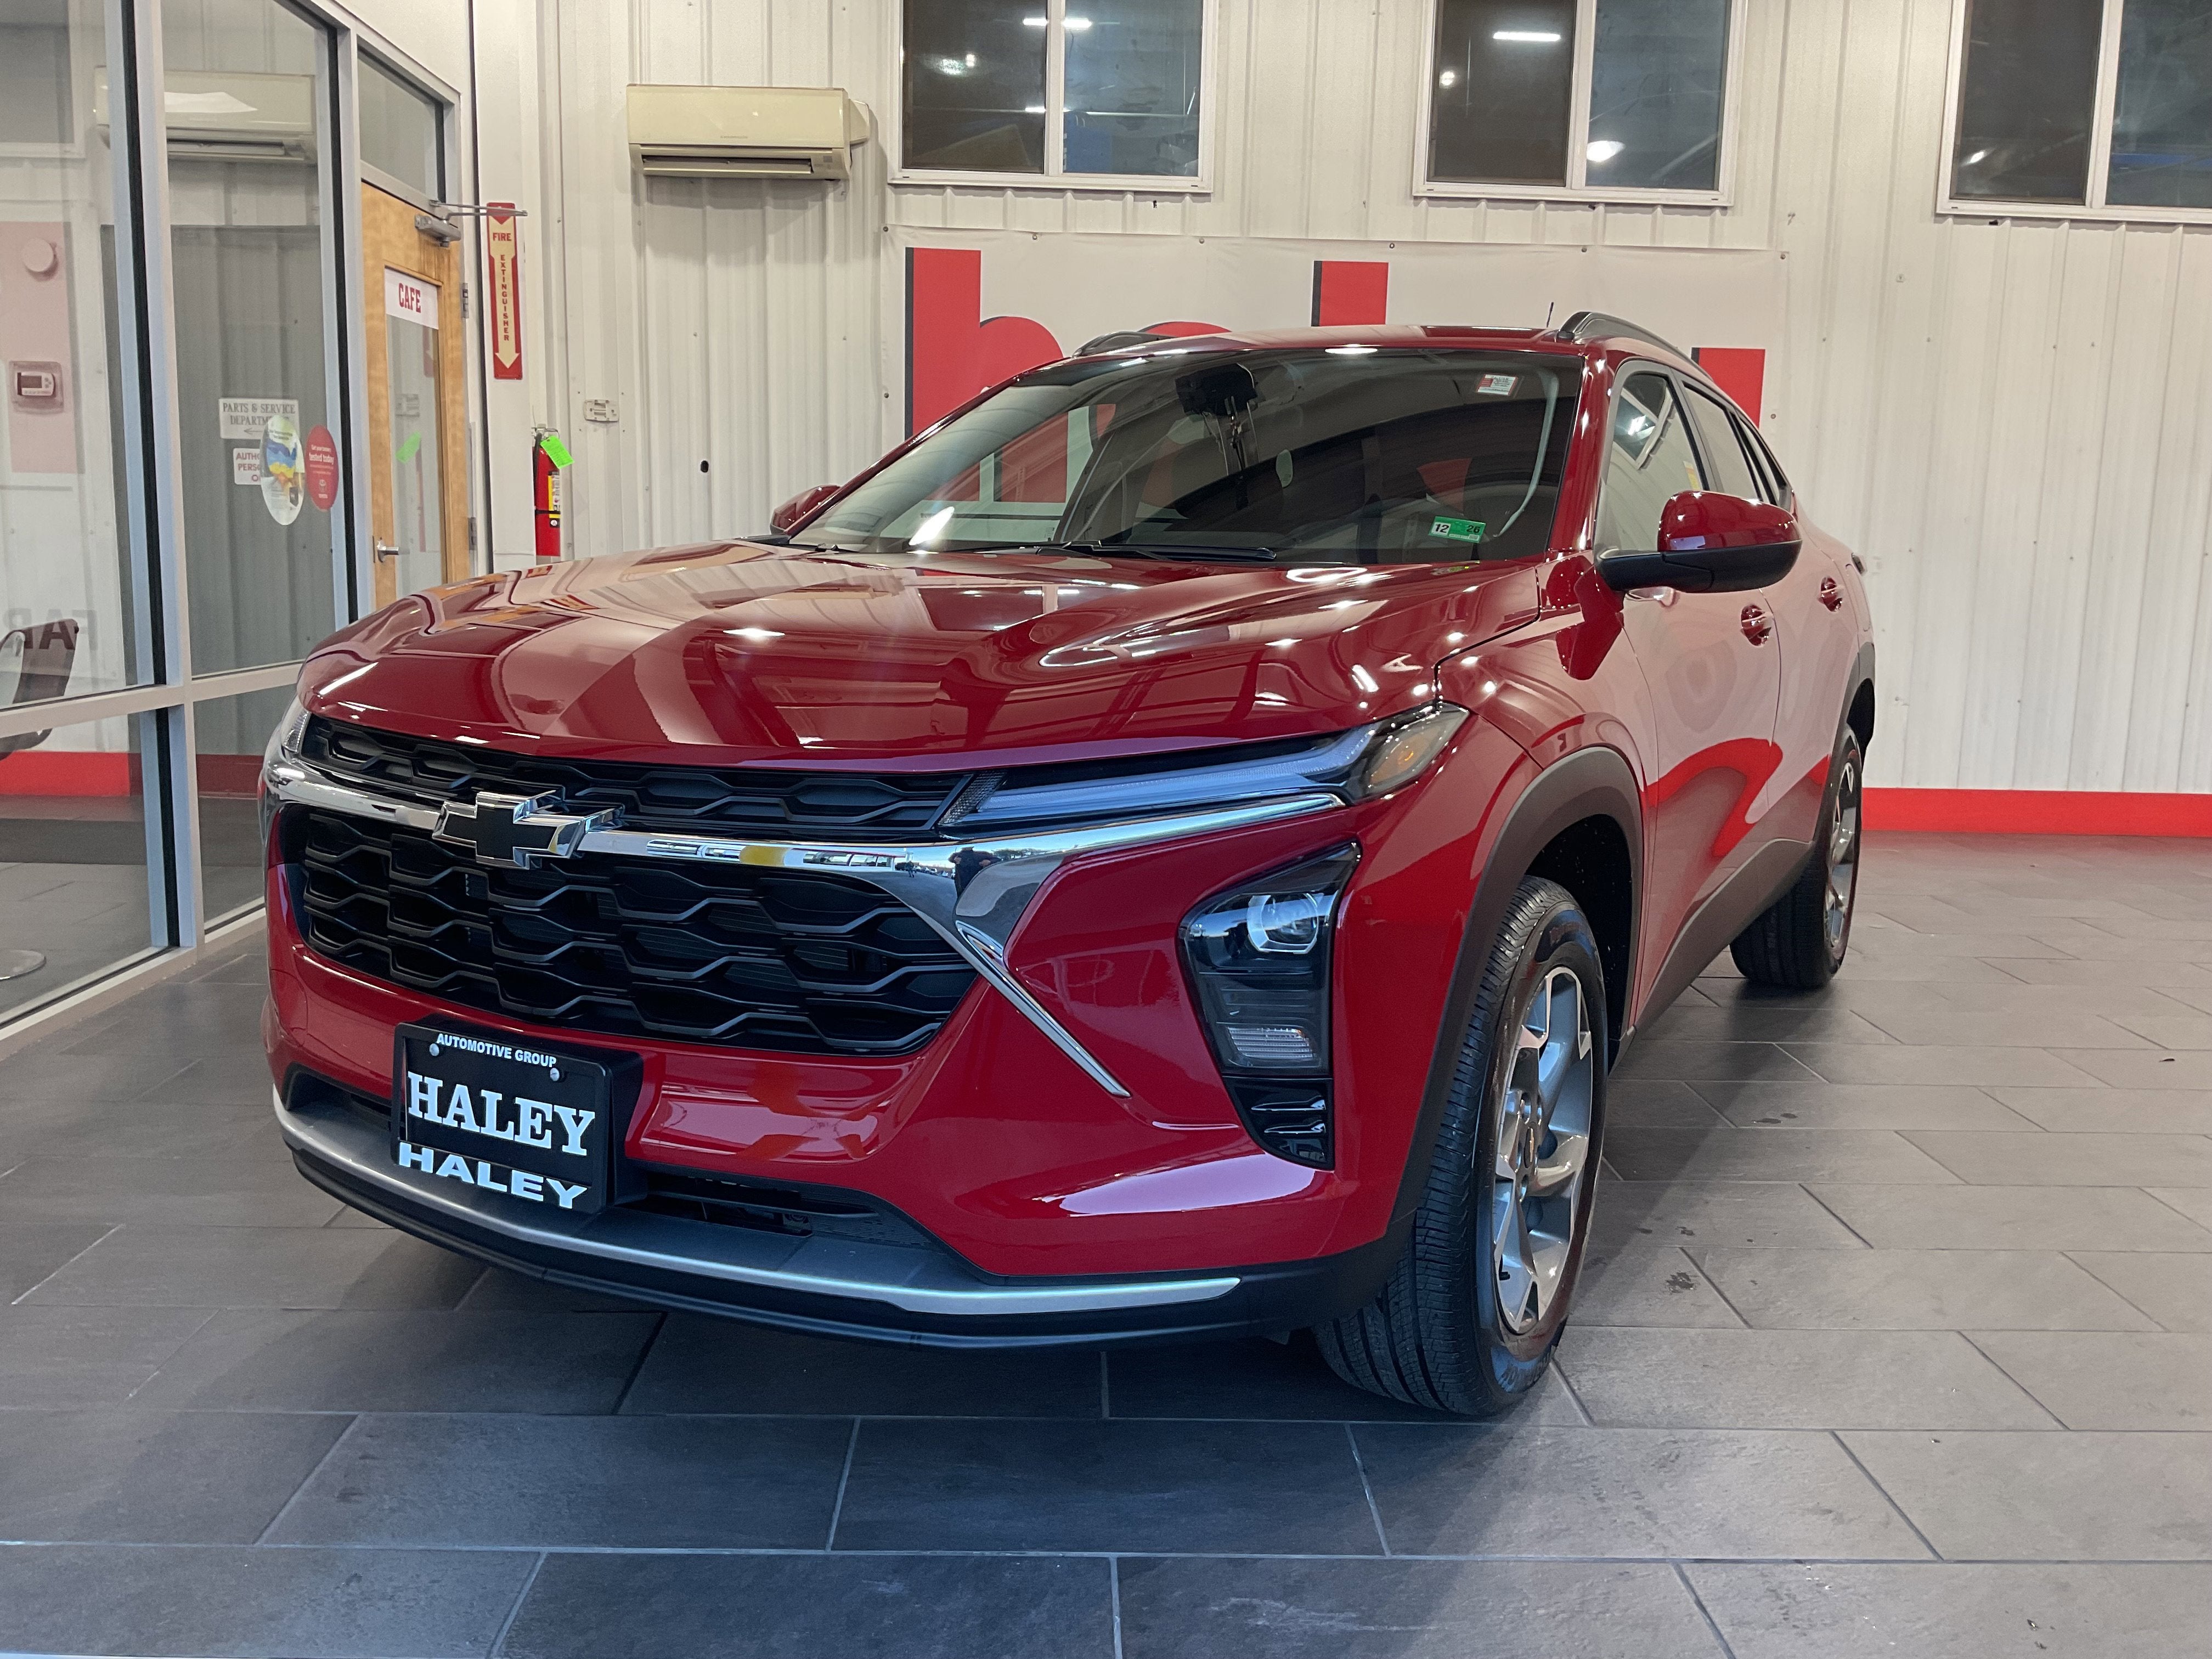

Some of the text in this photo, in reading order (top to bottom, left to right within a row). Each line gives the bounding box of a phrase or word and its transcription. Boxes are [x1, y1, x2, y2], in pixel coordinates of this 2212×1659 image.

[493, 232, 512, 241] FIRE
[398, 283, 421, 313] CAFE
[500, 254, 510, 341] EXTINGUISHER
[223, 402, 296, 414] PARTS & SERVICE
[230, 415, 289, 426] DEPARTM
[1435, 523, 1480, 533] 12 26
[436, 1032, 557, 1068] AUTOMOTIVE GROUP
[408, 1070, 596, 1156] HALEY
[398, 1141, 588, 1210] HALEY
